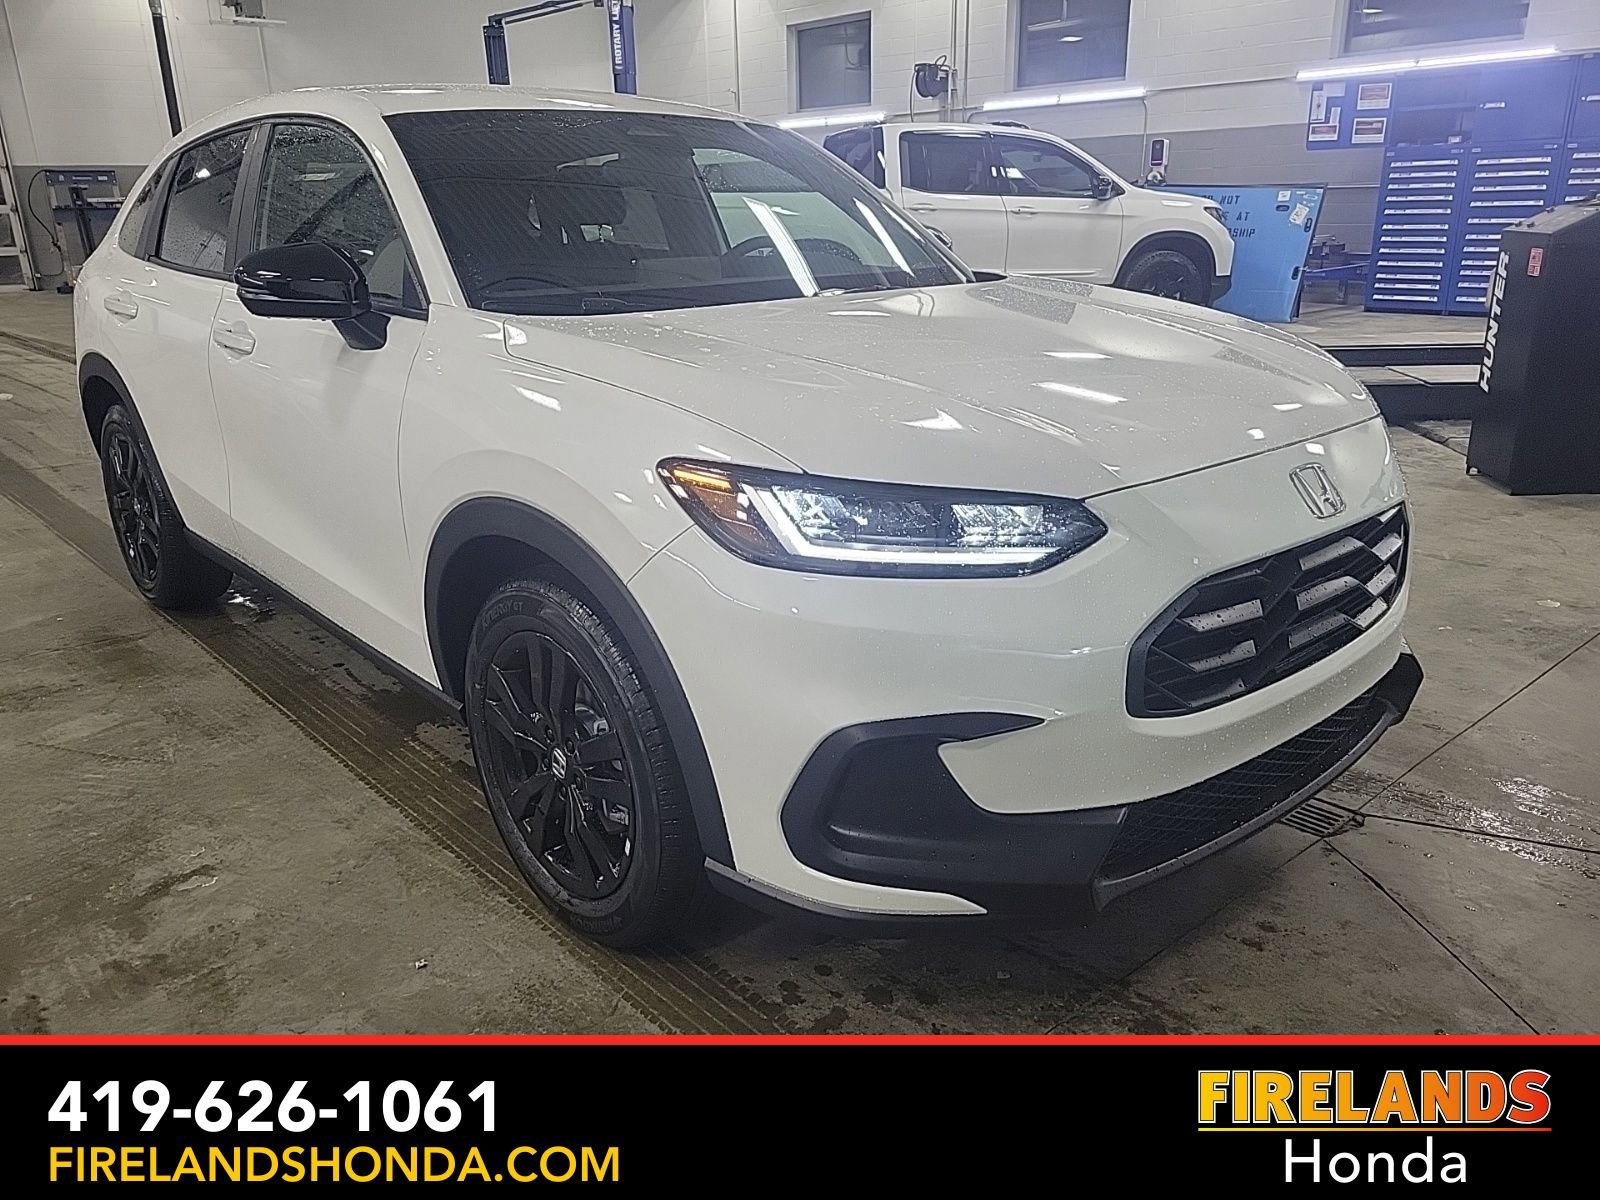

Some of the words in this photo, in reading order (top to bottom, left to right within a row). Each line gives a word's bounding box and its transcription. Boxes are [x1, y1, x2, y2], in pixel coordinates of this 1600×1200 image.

[612, 23, 622, 64] ROTARY
[1219, 195, 1240, 205] NOT
[1236, 211, 1251, 221] AT
[1480, 251, 1509, 393] HUNTER
